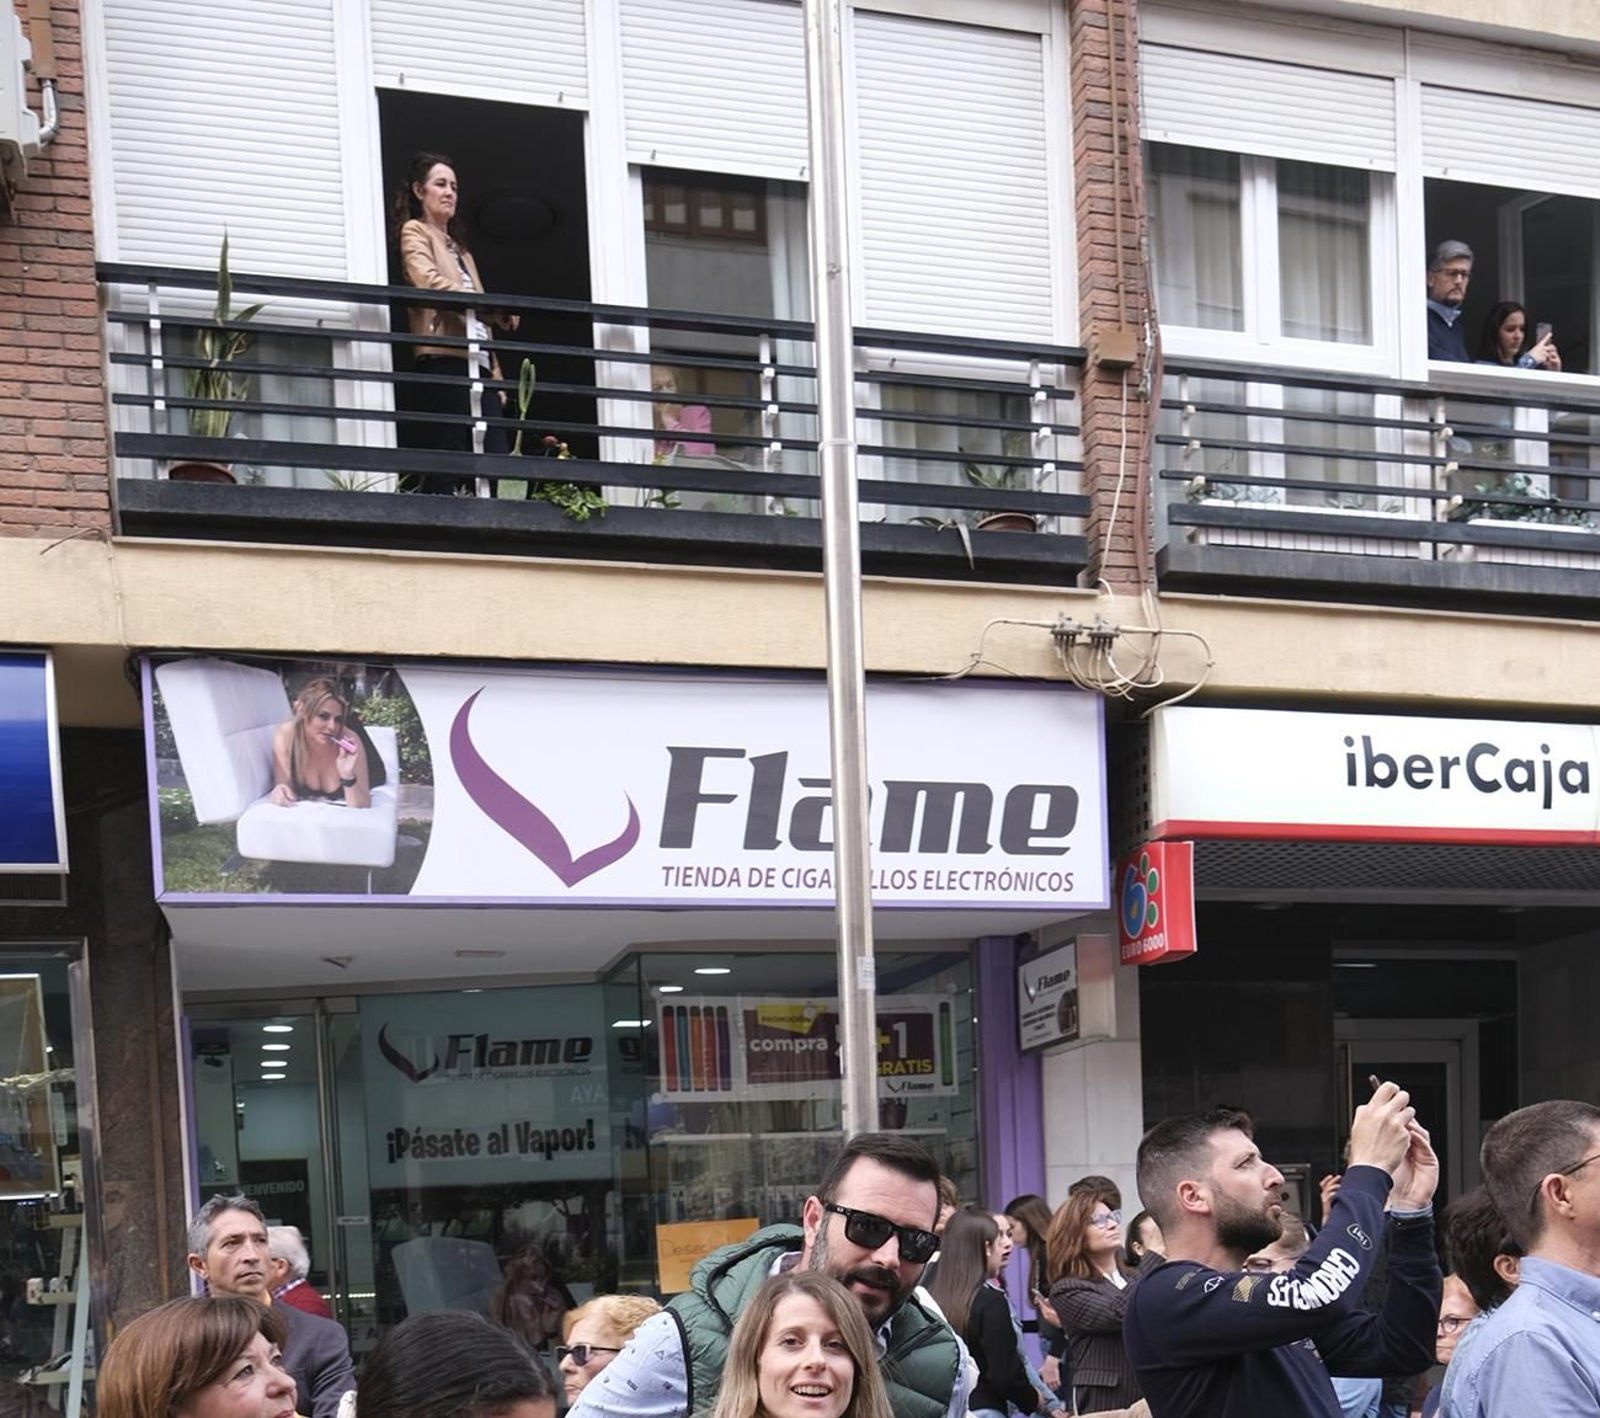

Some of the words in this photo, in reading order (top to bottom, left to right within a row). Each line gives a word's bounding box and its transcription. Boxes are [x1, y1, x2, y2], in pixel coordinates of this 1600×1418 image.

[1344, 735, 1590, 809] iberCaja
[659, 746, 1080, 856] Flame
[662, 866, 741, 887] TIENDA
[748, 867, 776, 888] DE
[923, 867, 1074, 892] ELECTRÓNICOS
[1143, 933, 1164, 953] 6000
[444, 1033, 593, 1069] Flame
[750, 1036, 828, 1054] compra
[386, 1126, 481, 1164] ¡Pásate
[487, 1123, 509, 1155] al
[514, 1118, 596, 1160] Vapor!
